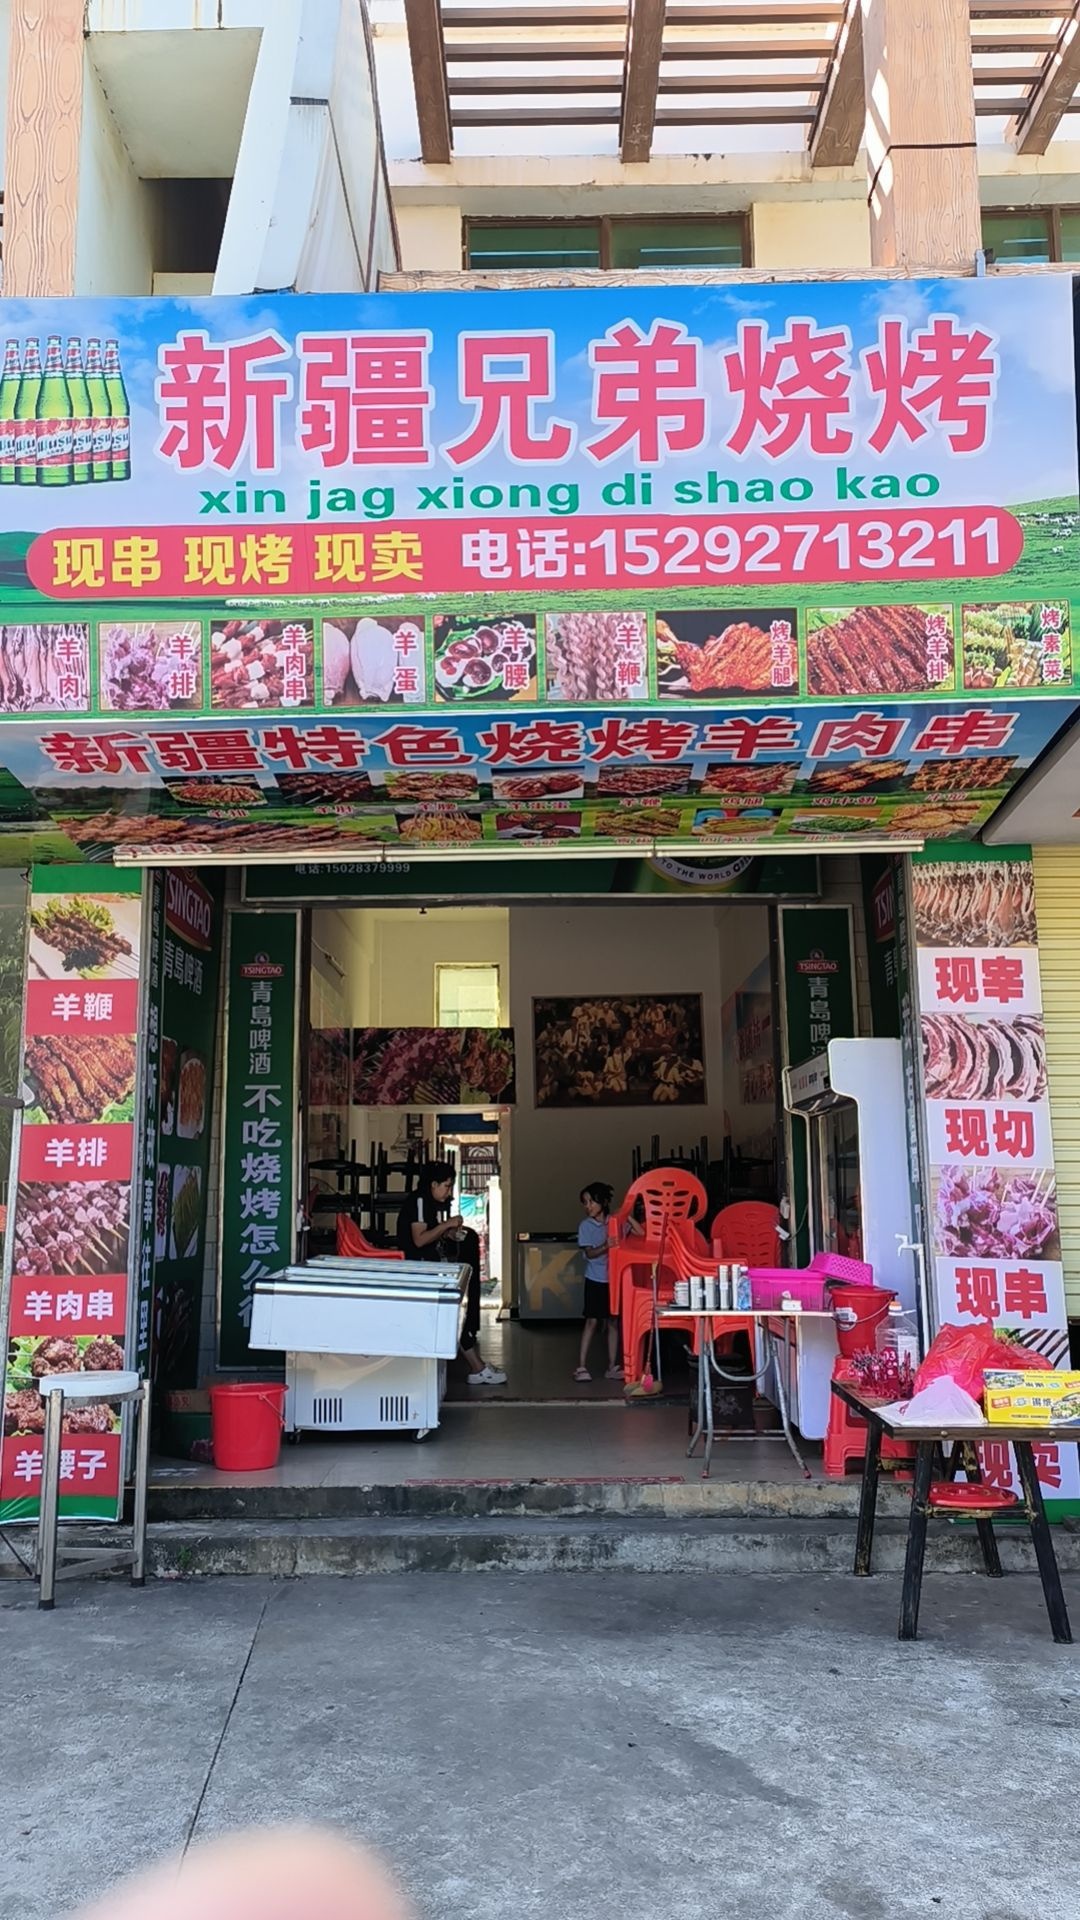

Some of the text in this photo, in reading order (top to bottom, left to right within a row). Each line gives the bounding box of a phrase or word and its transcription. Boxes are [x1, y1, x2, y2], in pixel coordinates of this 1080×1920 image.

[159, 318, 998, 471] 新疆兄弟烧烤
[199, 466, 940, 519] xin jag xiong di shao kao
[52, 516, 1000, 589] 现串 现烤 现卖 电话:15292713211
[57, 637, 80, 699] 羊肉
[171, 633, 195, 699] 羊排
[283, 625, 306, 700] 羊肉串
[394, 631, 418, 693] 羊蛋
[503, 626, 529, 689] 羊腰
[617, 624, 642, 688] 羊鞭
[770, 620, 792, 686] 烤羊腿
[926, 614, 948, 682] 烤羊排
[1040, 607, 1064, 681] 烤素菜
[40, 709, 1018, 774] 新疆特色烧烤羊肉串
[166, 869, 211, 937] SINGTAO
[675, 867, 694, 878] THE
[699, 870, 732, 880] WORLD
[243, 965, 282, 975] TSINGTAO
[798, 961, 837, 971] TSINGTAO
[934, 955, 1024, 1004] 现宰
[52, 992, 113, 1022] 羊鞭
[44, 1137, 108, 1168] 羊排
[945, 1108, 1034, 1158] 现切
[24, 1289, 114, 1322] 羊肉串
[955, 1267, 1048, 1320] 现串
